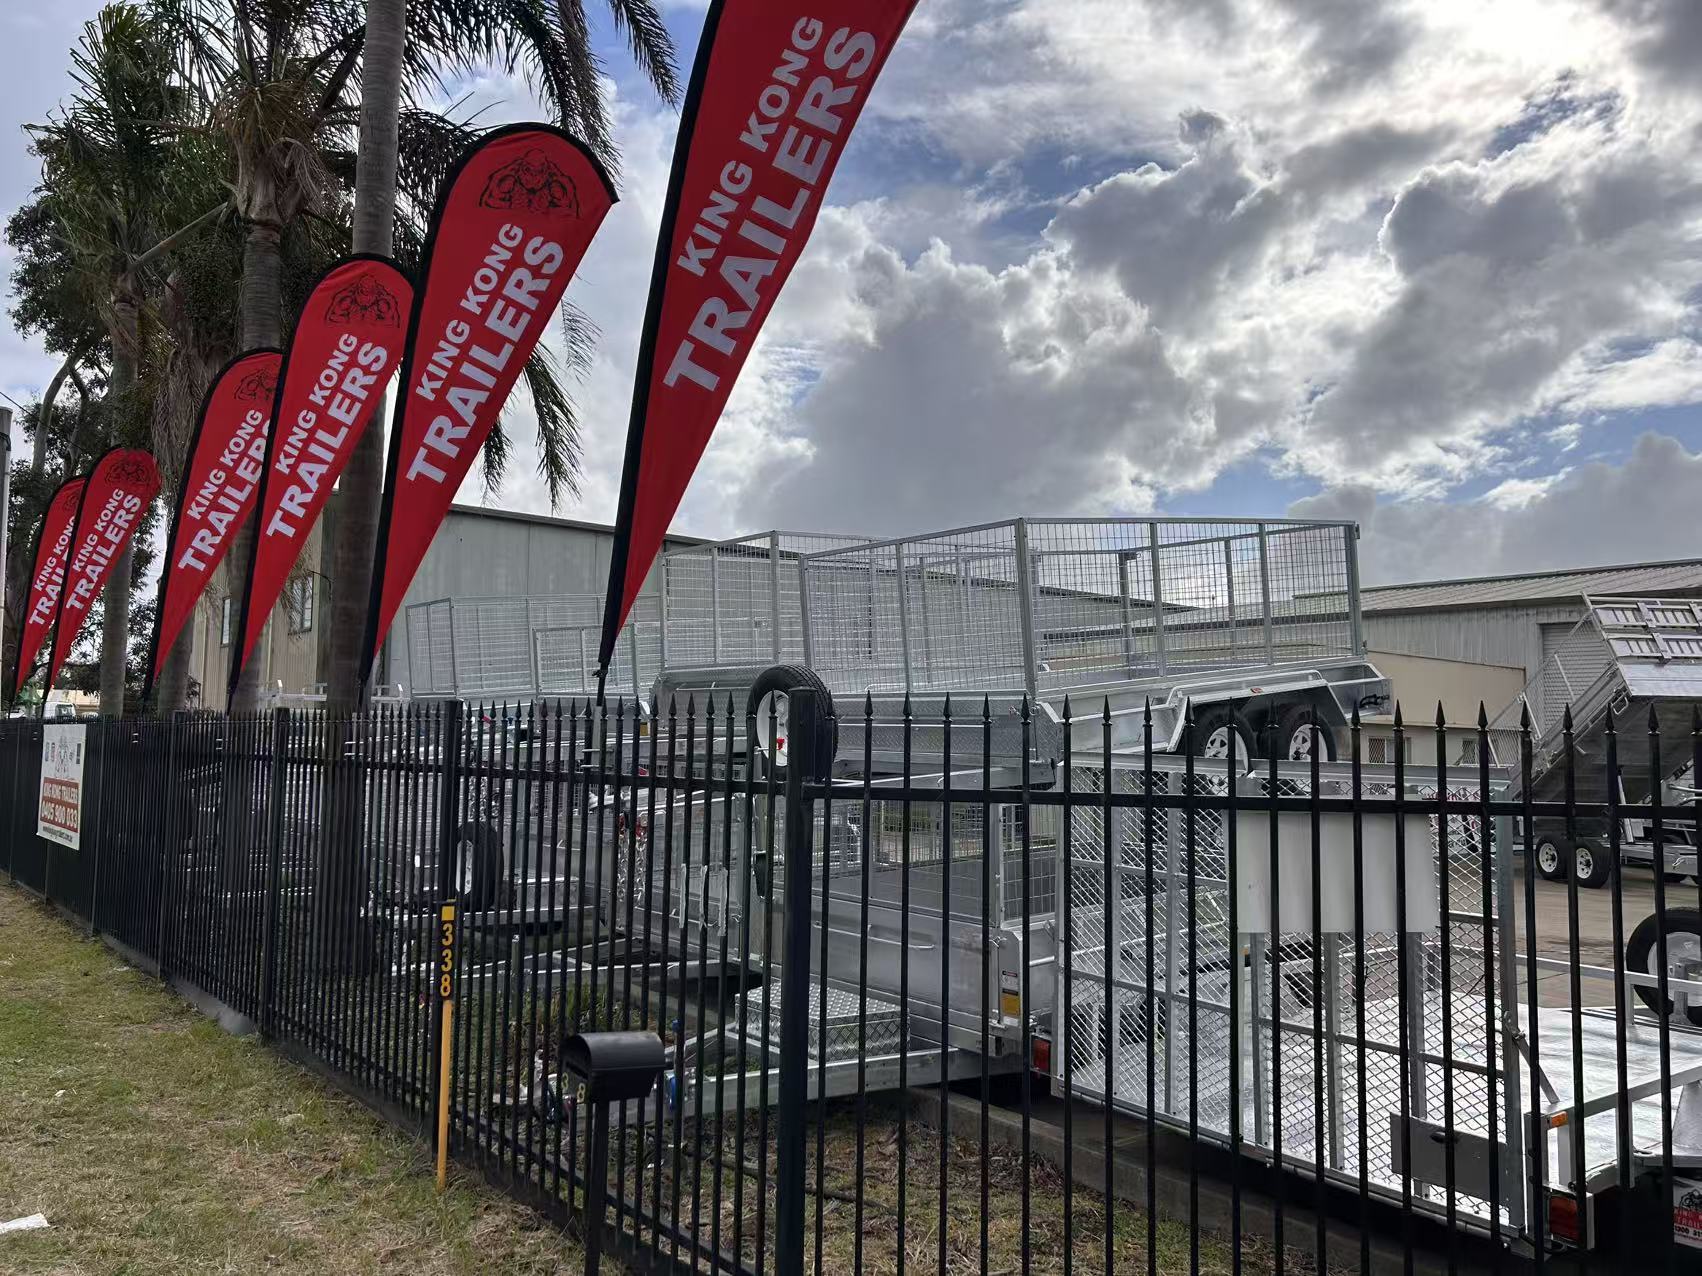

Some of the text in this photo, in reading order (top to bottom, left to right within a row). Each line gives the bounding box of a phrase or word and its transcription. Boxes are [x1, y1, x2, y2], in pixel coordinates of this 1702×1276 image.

[663, 27, 876, 392] TRAILERS
[677, 16, 823, 277] KING KONG
[406, 236, 564, 483] TRAILERS
[416, 223, 523, 400] KING KONG
[187, 409, 263, 520] KING KONG
[266, 342, 388, 538] TRAILERS
[275, 333, 358, 474] KING KONG
[65, 494, 141, 609] TRAILERS
[73, 488, 124, 572] KING KONG
[177, 419, 270, 571] TRAILER
[34, 556, 57, 591] KING
[440, 922, 454, 997] 338
